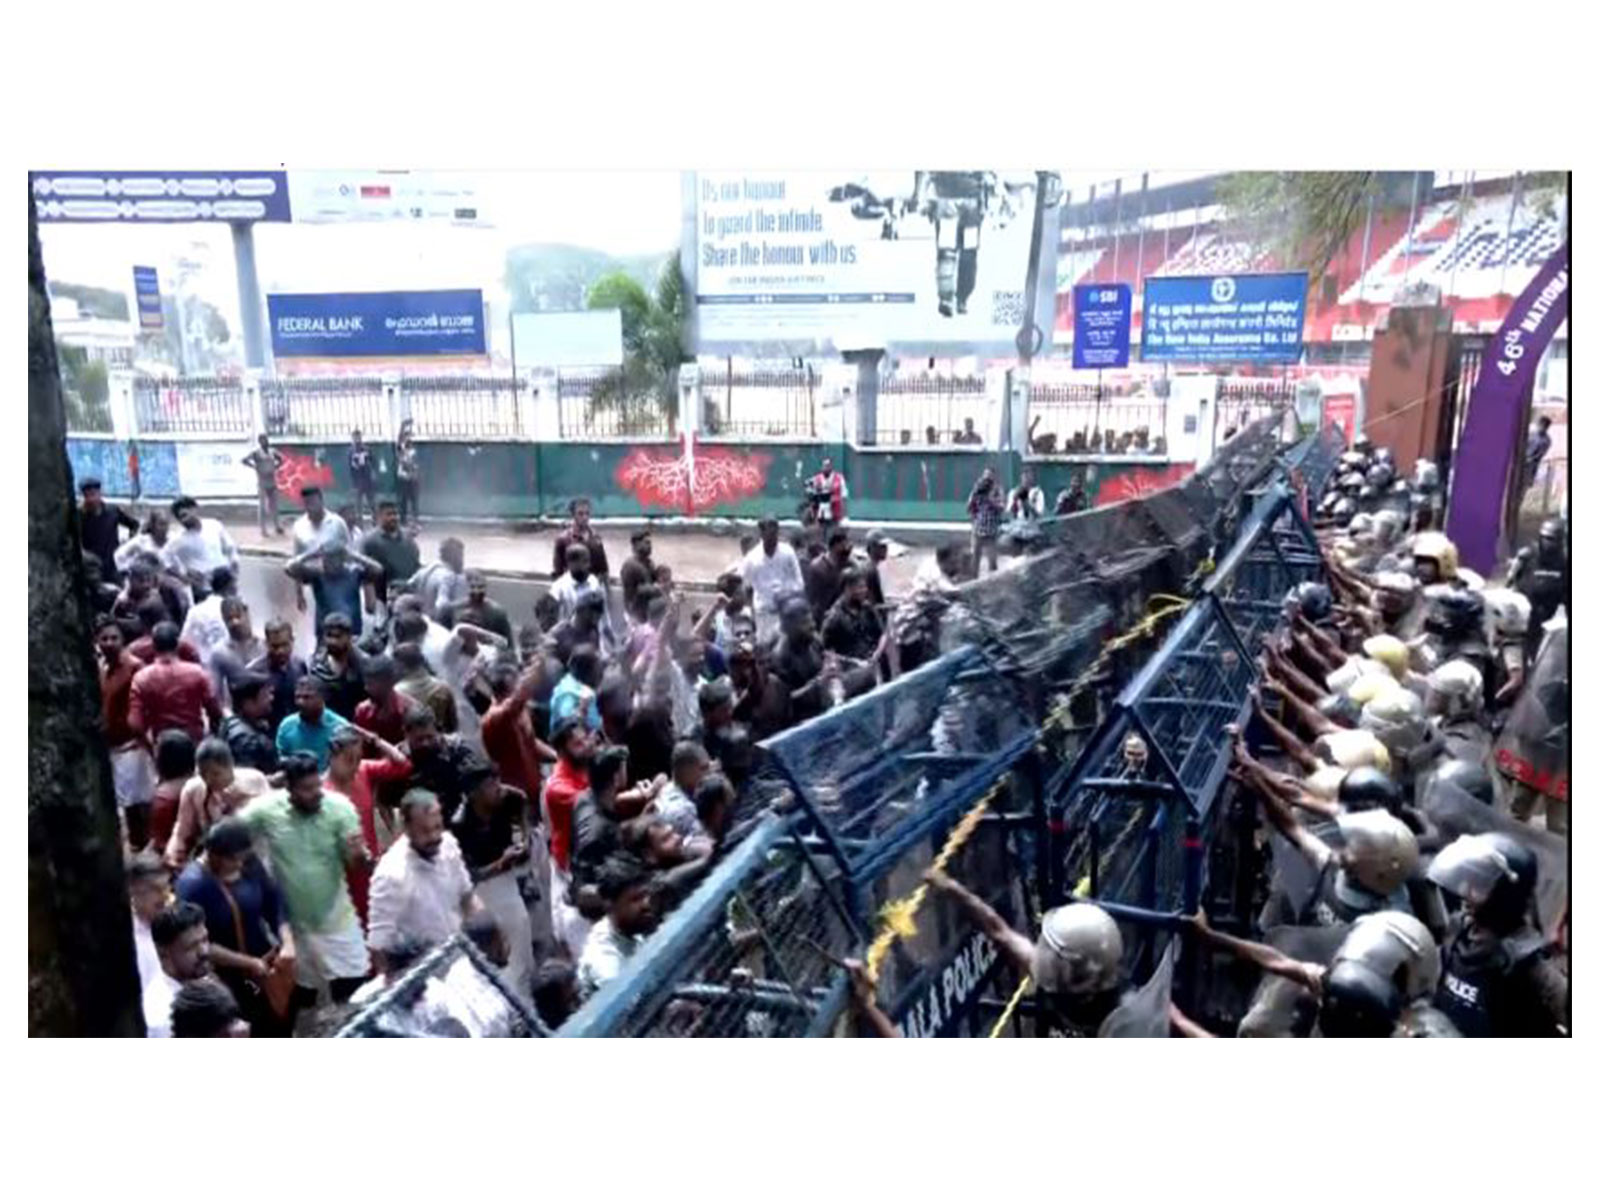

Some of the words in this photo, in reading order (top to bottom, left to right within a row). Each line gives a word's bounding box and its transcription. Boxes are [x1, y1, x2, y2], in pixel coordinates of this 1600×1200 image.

[756, 207, 775, 232] the
[703, 242, 737, 267] Share
[740, 241, 760, 266] the
[763, 239, 804, 265] honour
[809, 239, 837, 264] with
[1520, 264, 1568, 333] NATIONA
[278, 317, 325, 331] FEDERAL
[329, 316, 364, 331] BANK
[943, 931, 998, 1018] POLIC
